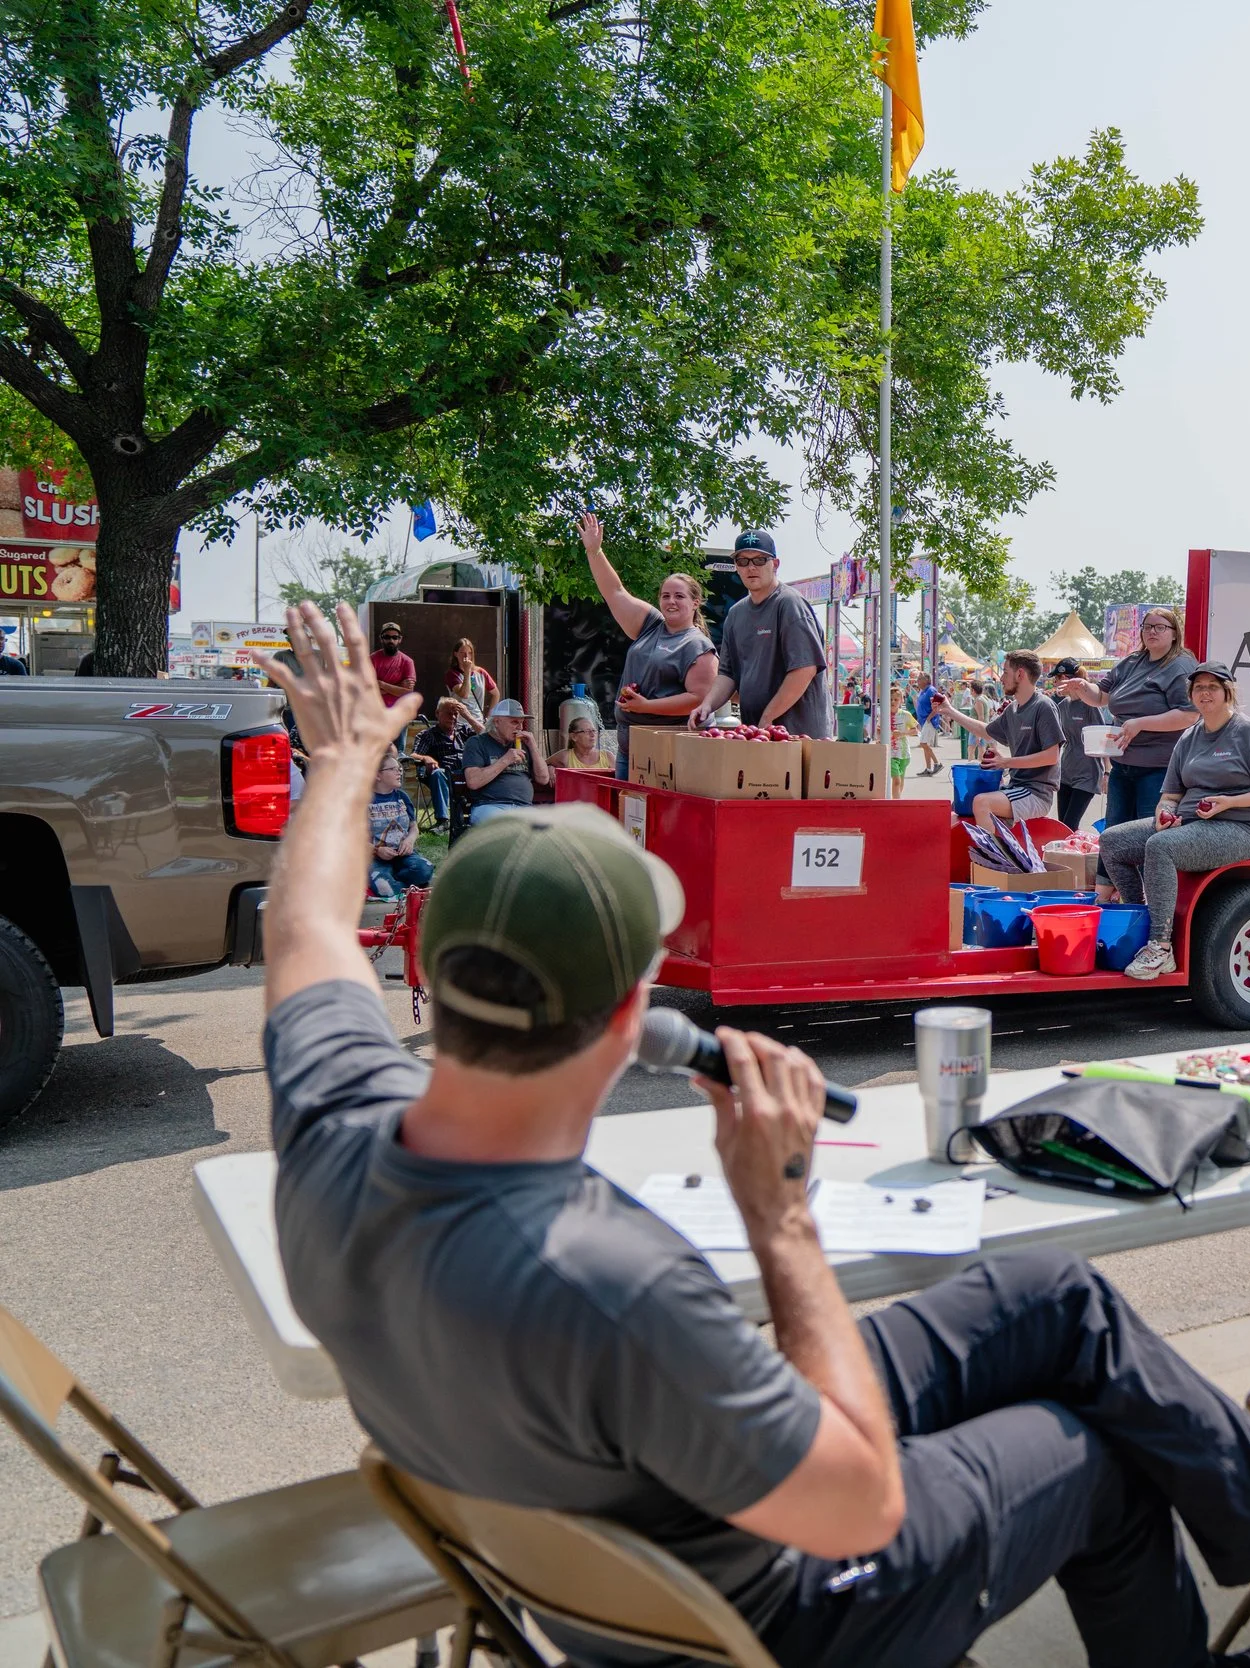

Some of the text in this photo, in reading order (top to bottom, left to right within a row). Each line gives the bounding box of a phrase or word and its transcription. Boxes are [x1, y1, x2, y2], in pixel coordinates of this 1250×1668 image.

[0, 548, 46, 561] Sugared
[236, 630, 250, 640] FRY
[251, 626, 277, 635] BREAD
[235, 656, 251, 664] FRY
[124, 702, 233, 720] Z71
[801, 848, 840, 868] 152
